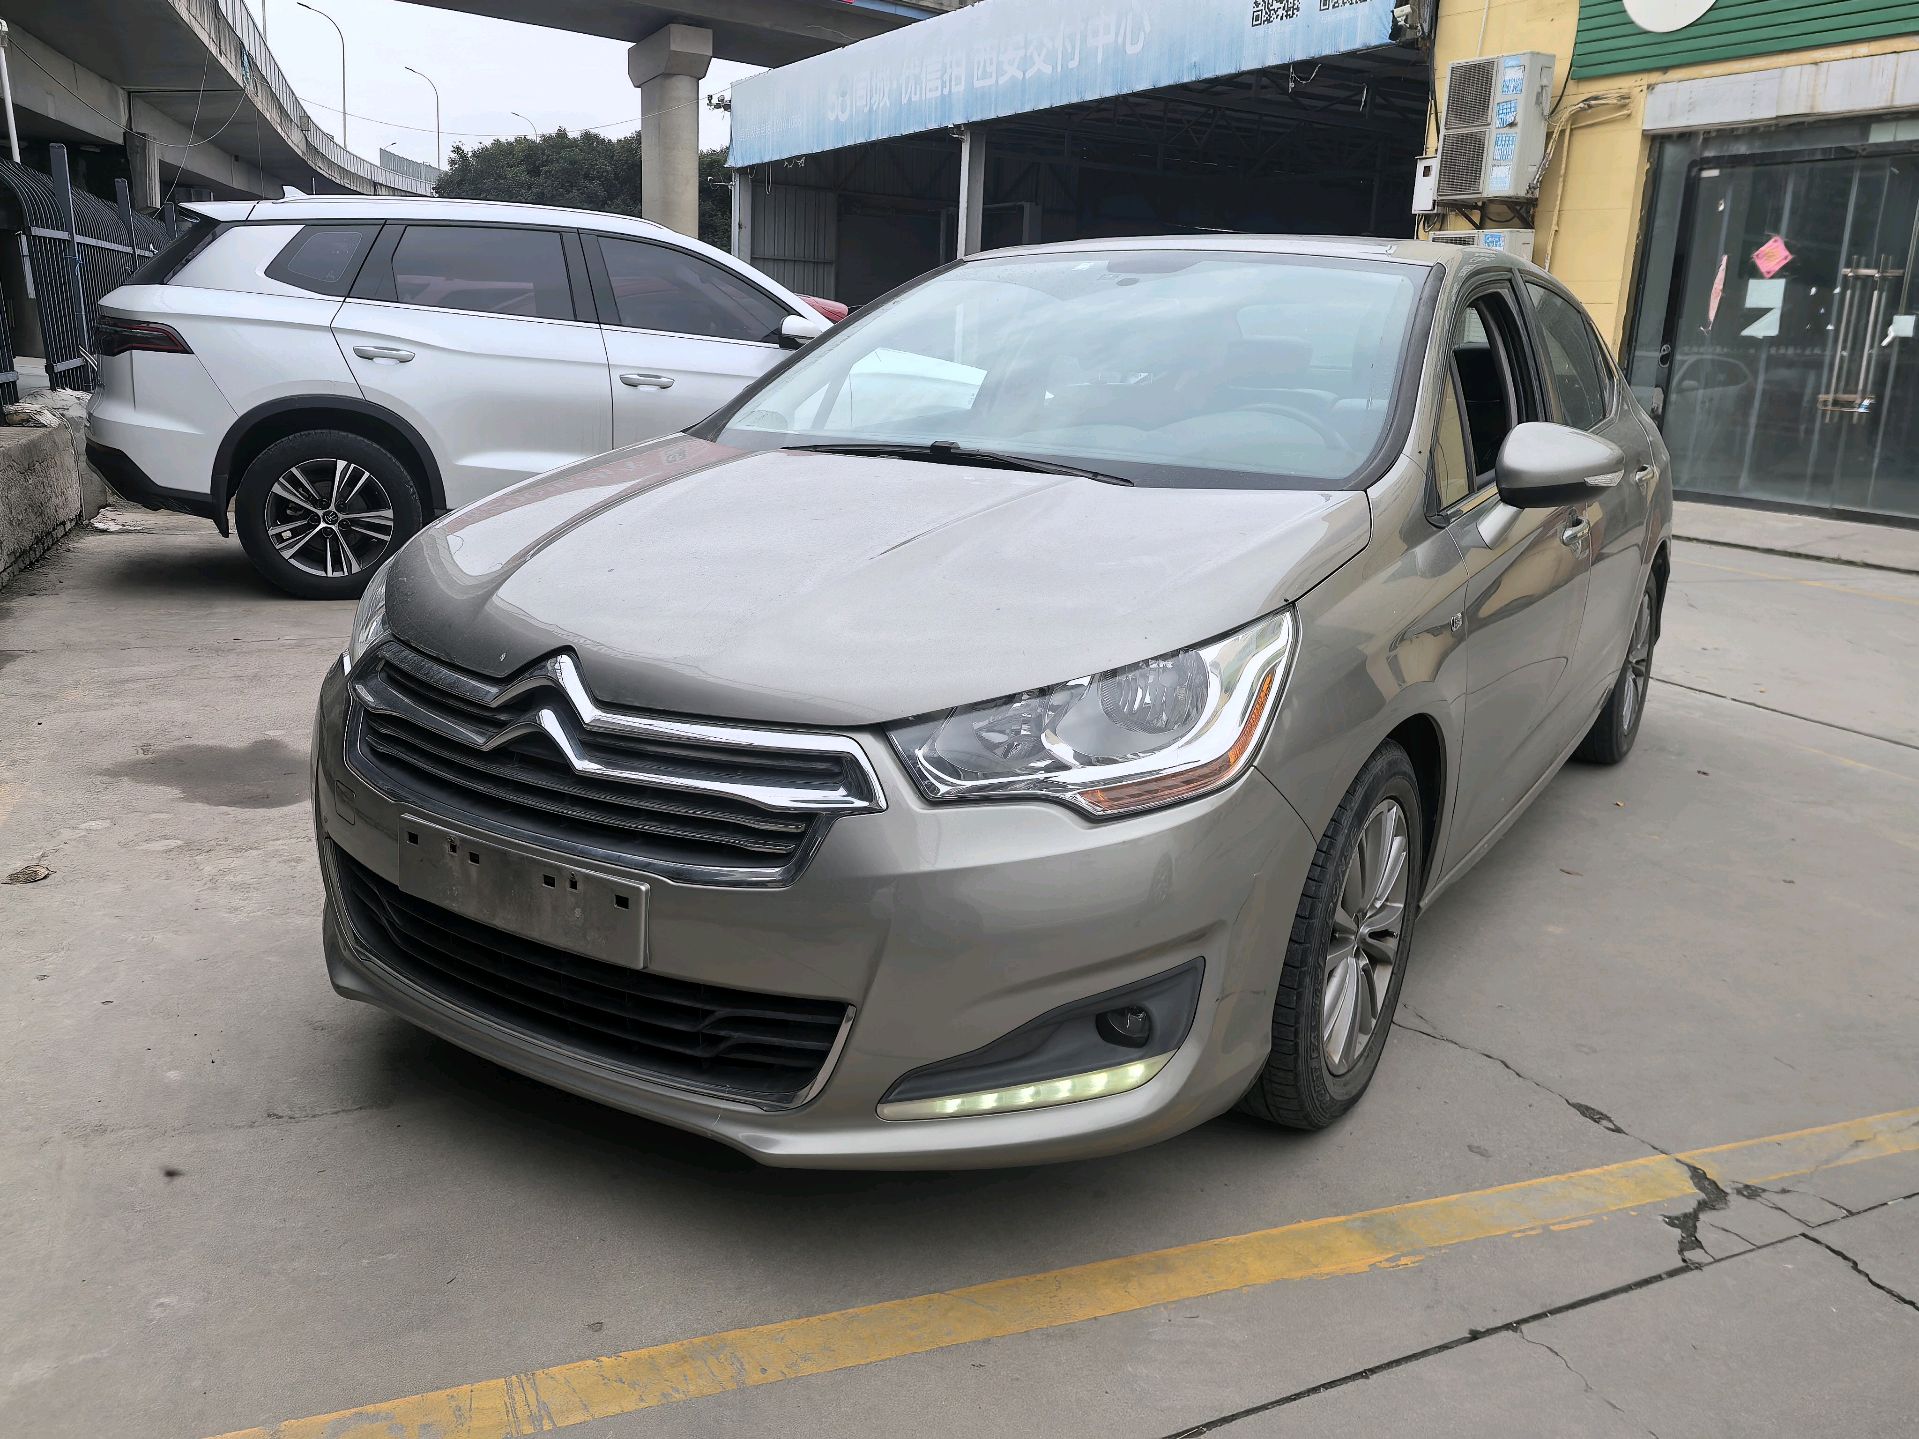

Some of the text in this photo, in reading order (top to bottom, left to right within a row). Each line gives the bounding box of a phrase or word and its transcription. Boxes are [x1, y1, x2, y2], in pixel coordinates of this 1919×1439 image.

[973, 9, 1151, 89] 西安交付中心
